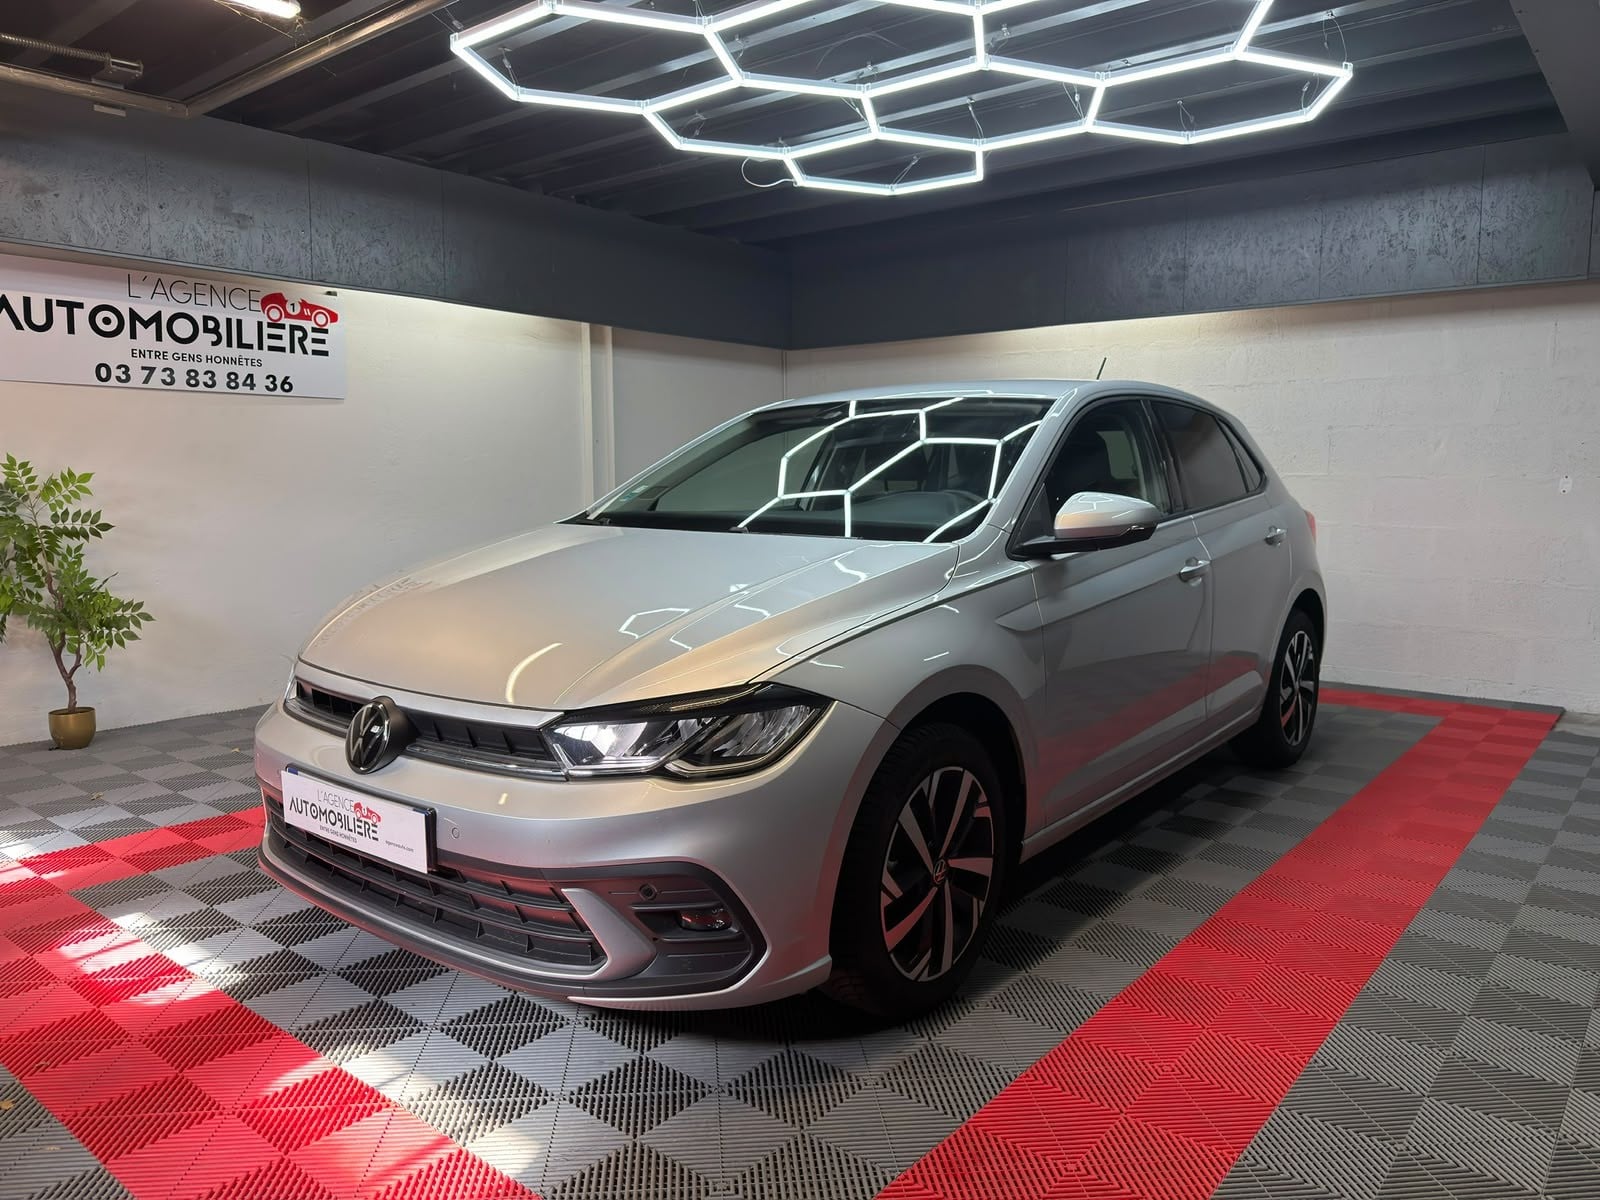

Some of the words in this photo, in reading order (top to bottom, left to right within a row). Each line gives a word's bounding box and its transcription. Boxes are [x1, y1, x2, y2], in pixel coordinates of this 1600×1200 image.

[127, 273, 261, 312] L'AGENCE
[131, 348, 169, 361] ENTRE
[172, 352, 202, 363] GENS
[206, 355, 263, 367] HONNÊTES
[95, 362, 131, 384] 03
[141, 366, 176, 386] 73
[185, 369, 217, 388] 83
[226, 372, 257, 391] 84
[264, 374, 294, 393] 36
